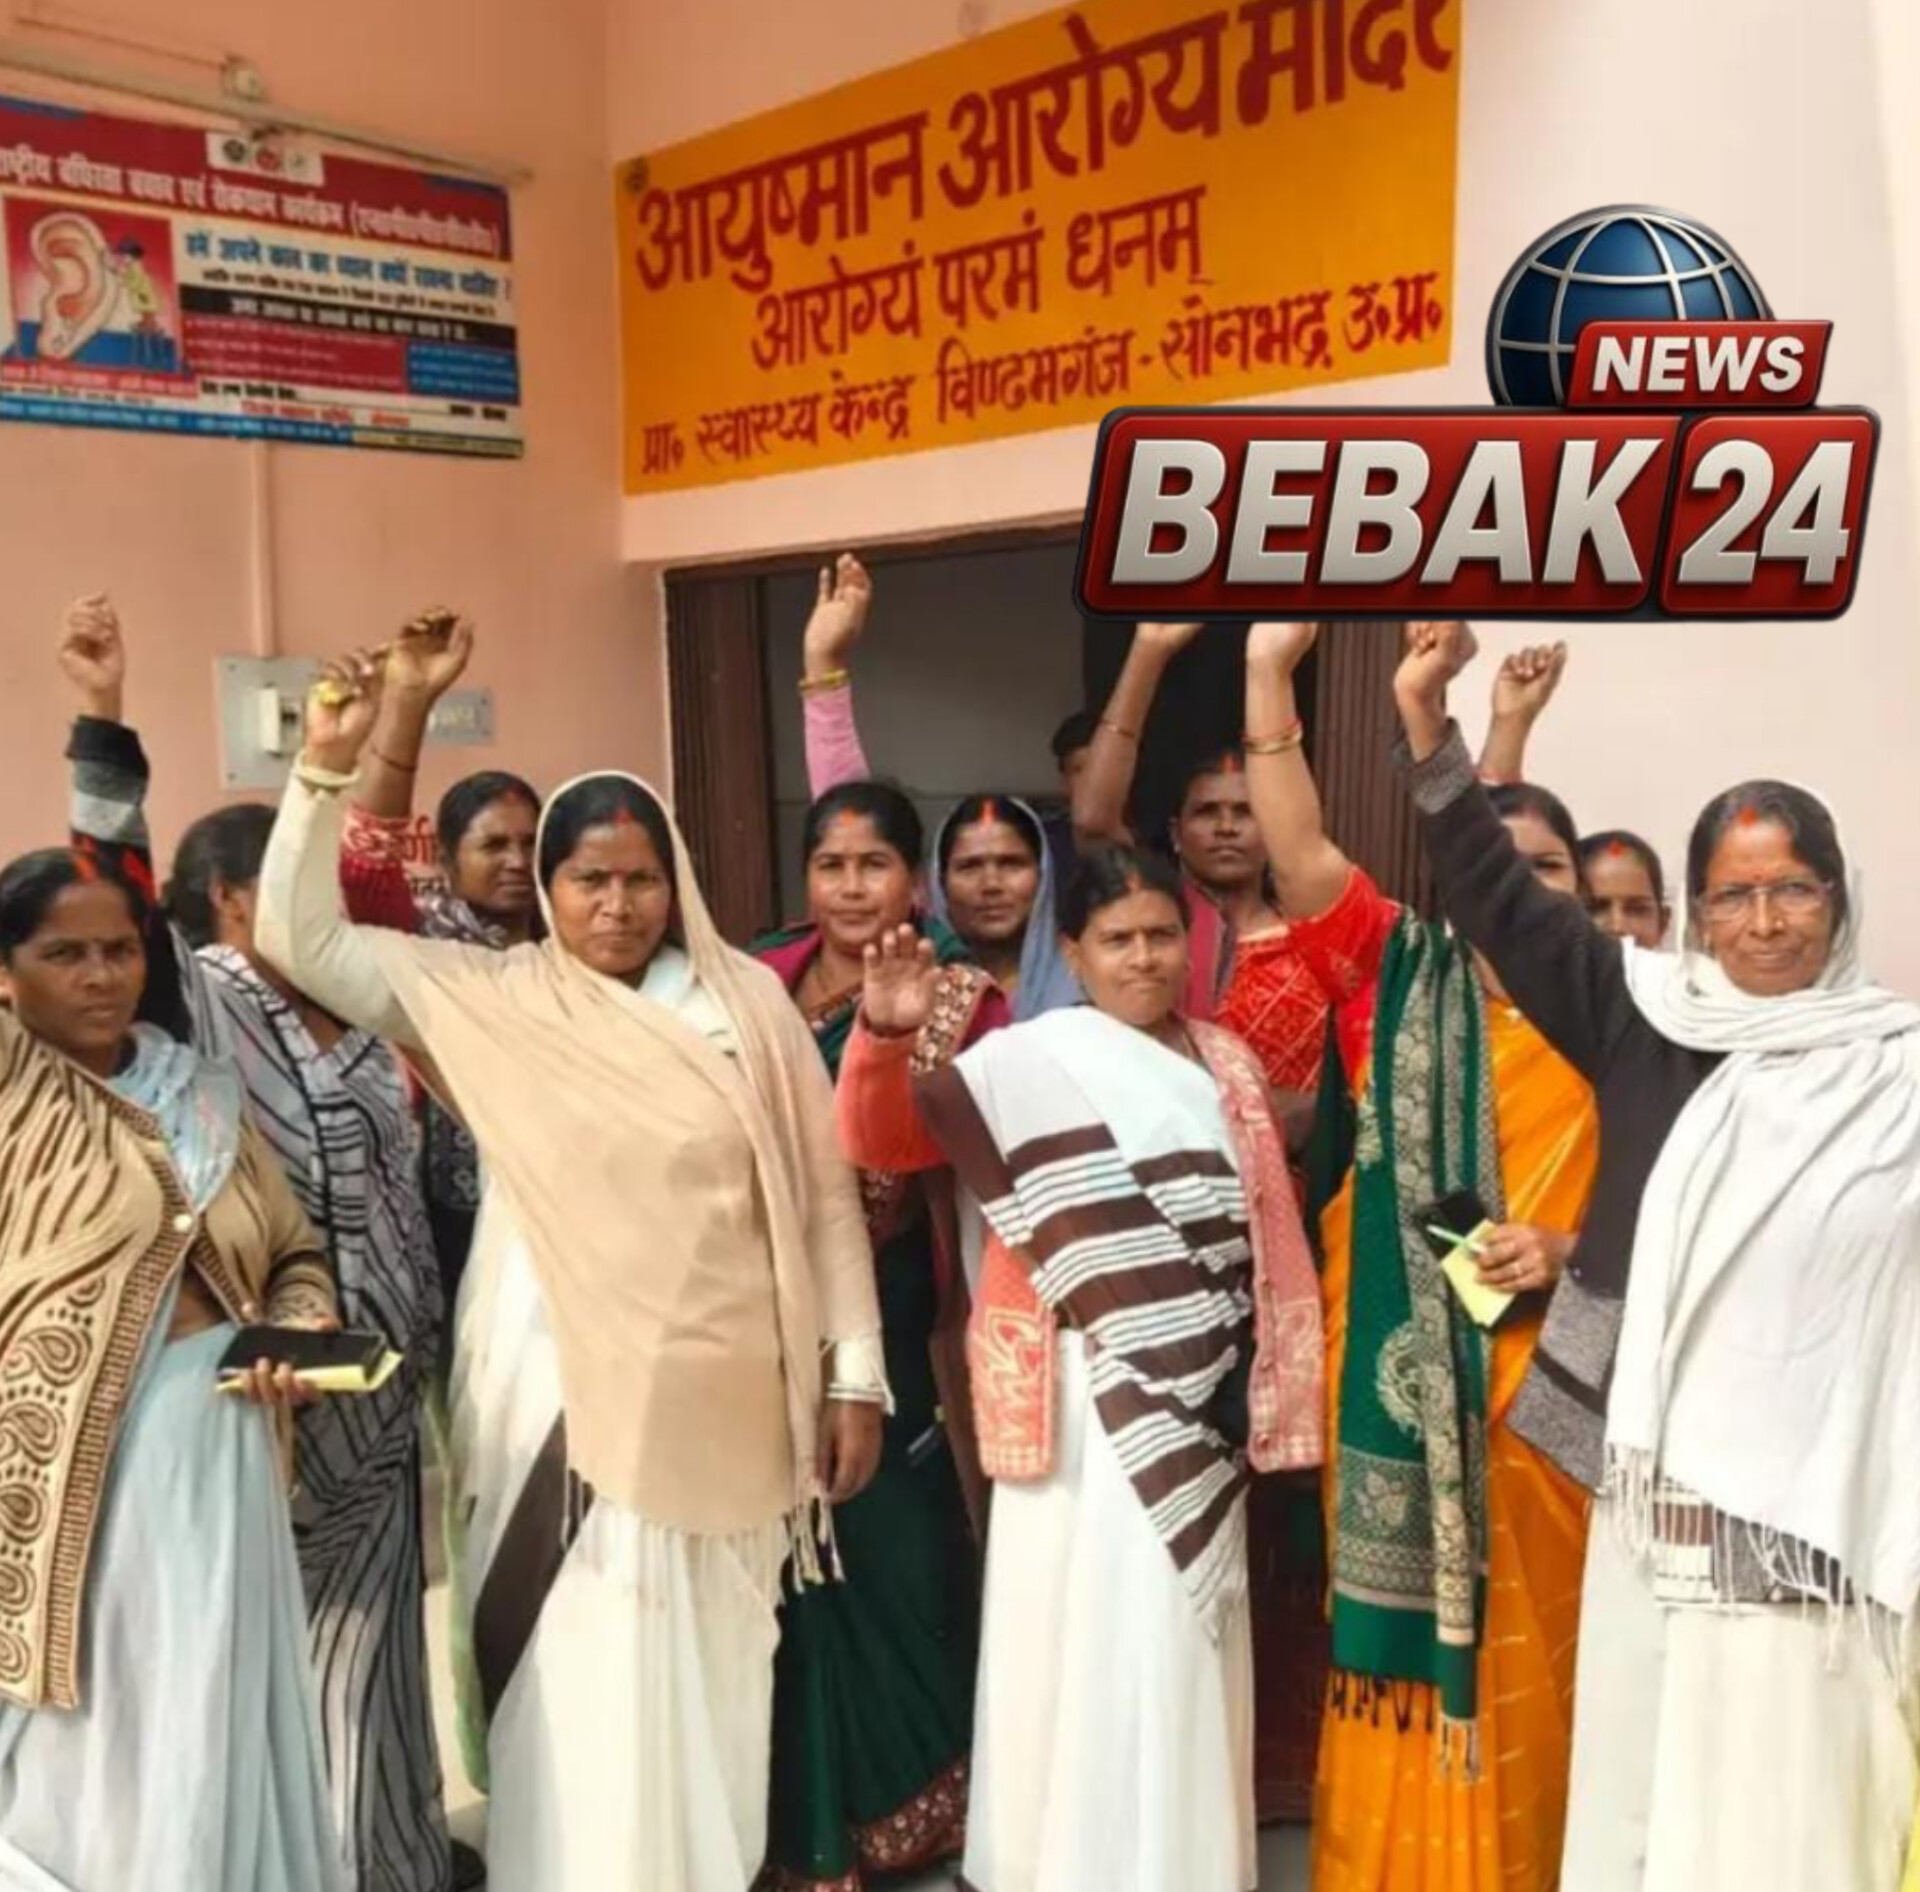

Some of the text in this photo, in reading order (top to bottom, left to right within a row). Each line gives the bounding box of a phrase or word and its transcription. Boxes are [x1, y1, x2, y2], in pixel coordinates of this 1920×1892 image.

[636, 0, 1454, 292] आयुष्मान आरोग्य मदिर
[751, 184, 1214, 371] आरोग्यं परमं धनम्
